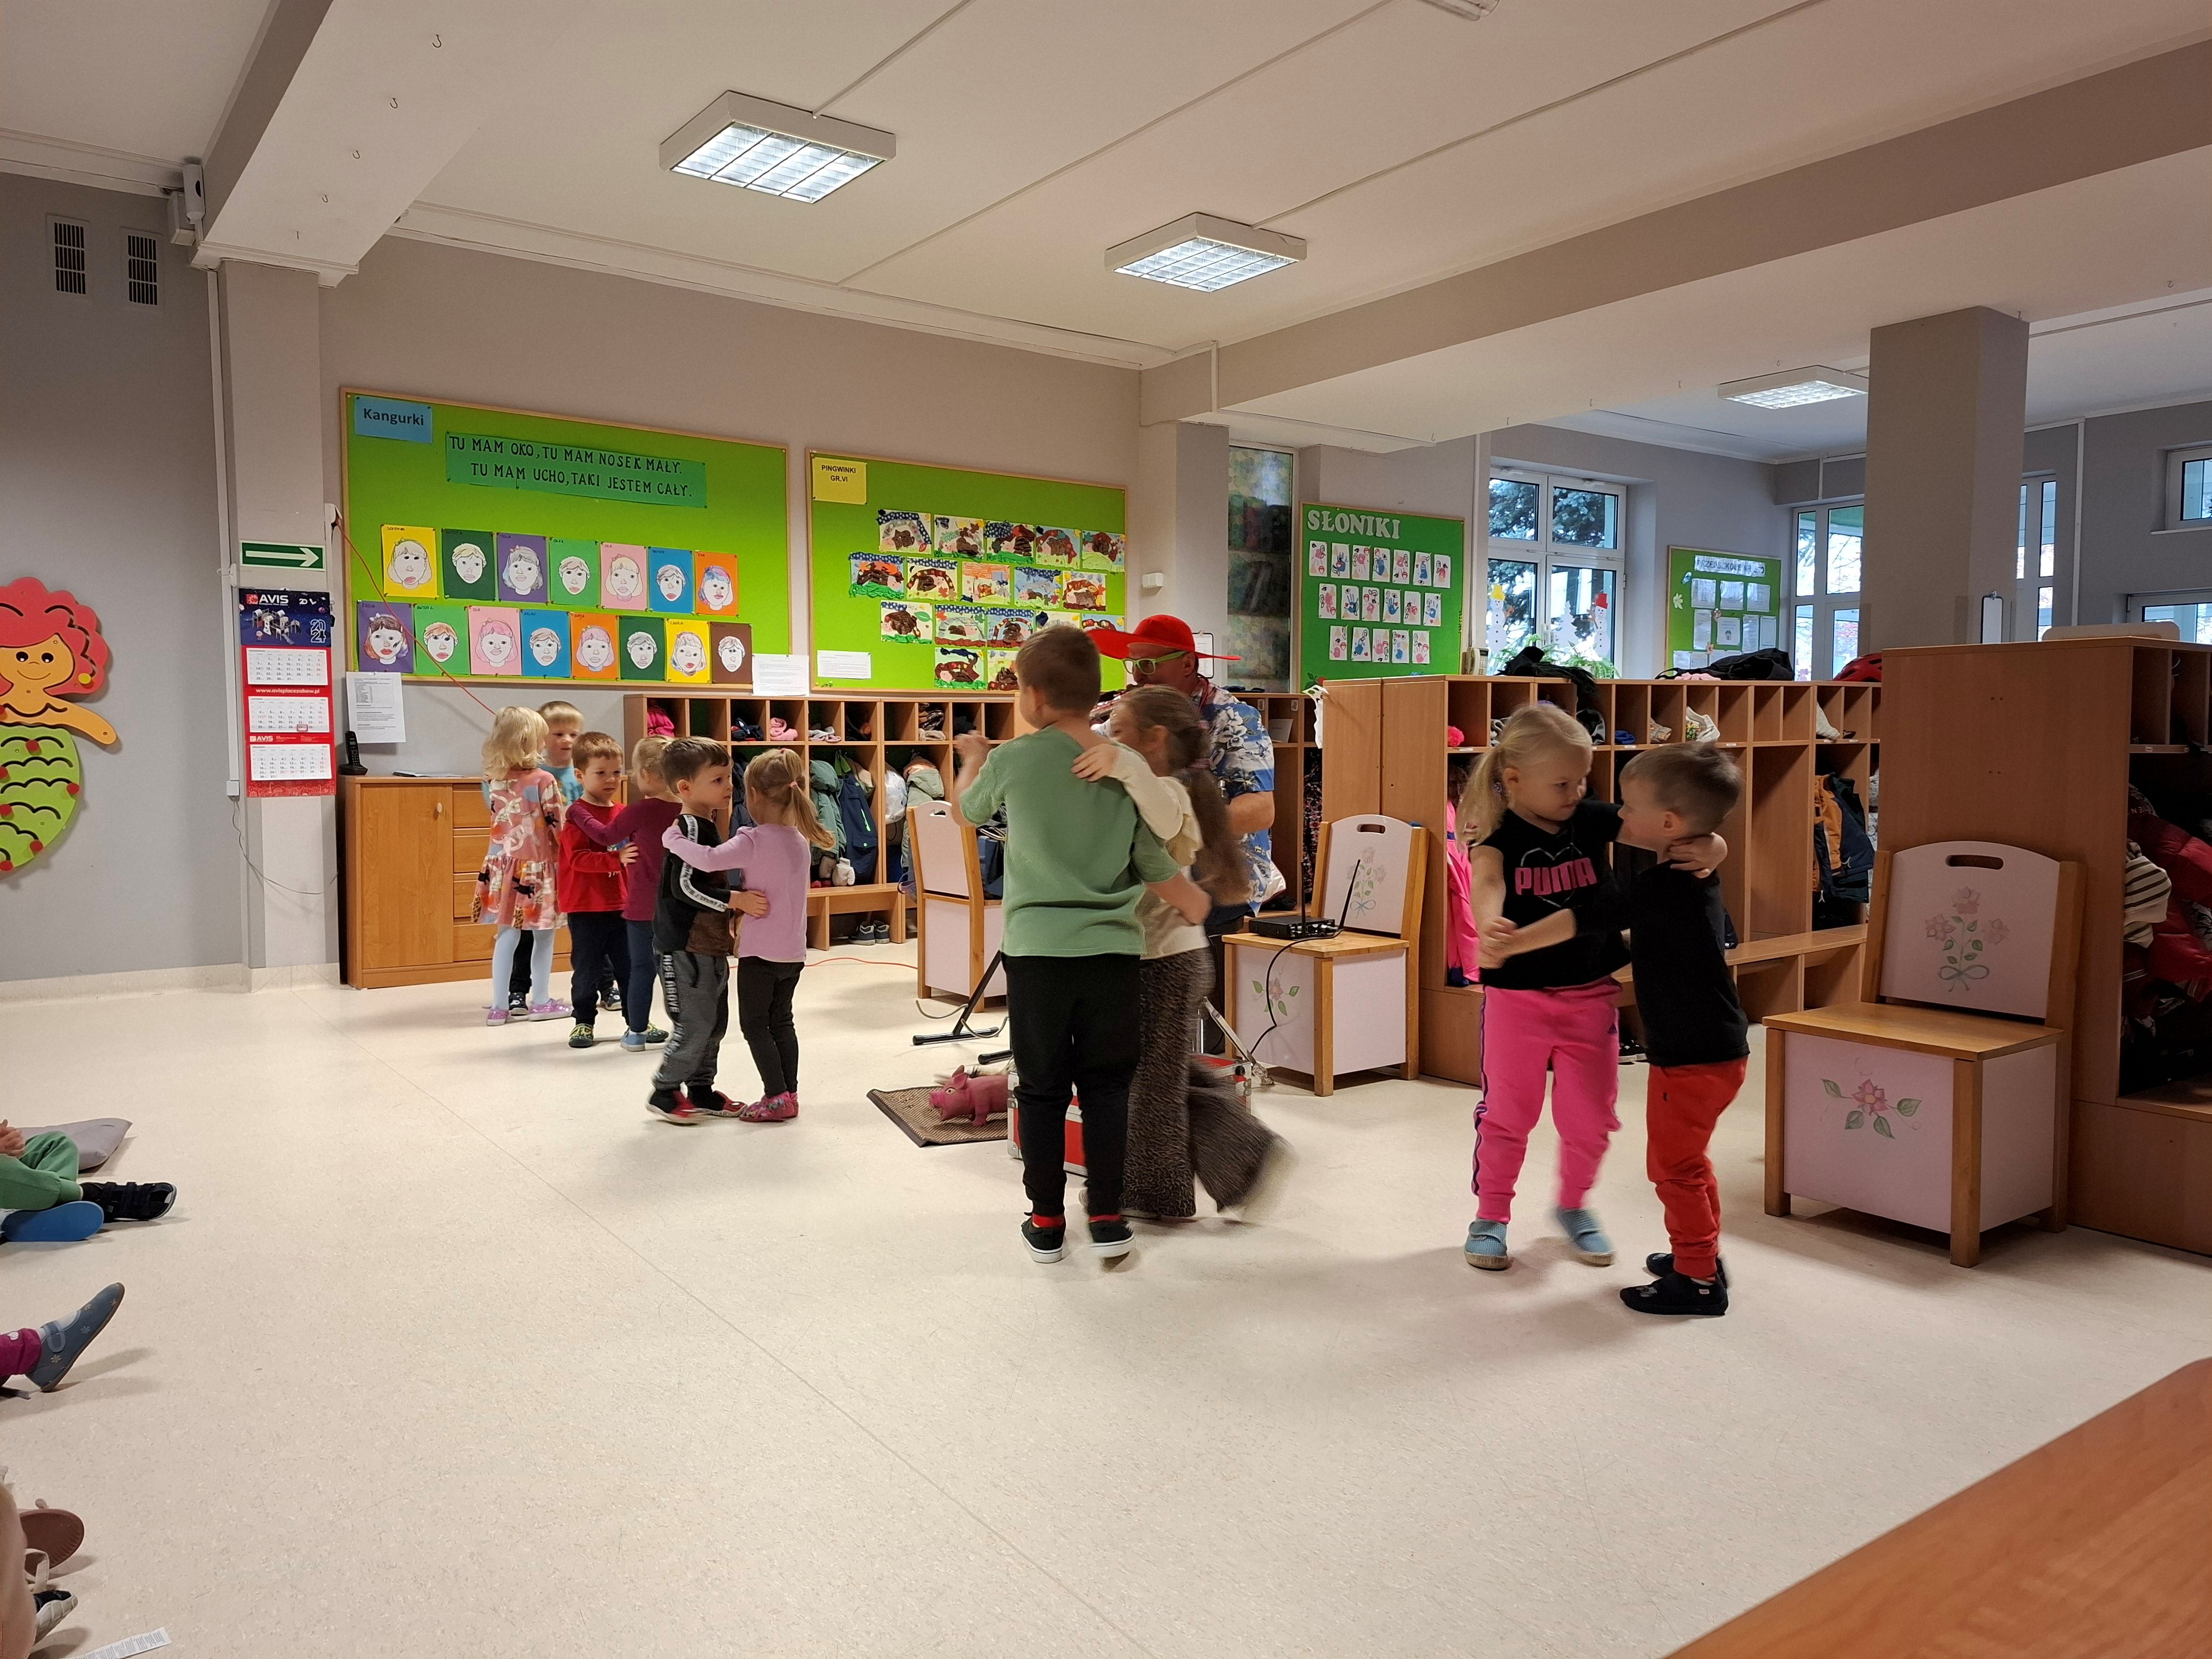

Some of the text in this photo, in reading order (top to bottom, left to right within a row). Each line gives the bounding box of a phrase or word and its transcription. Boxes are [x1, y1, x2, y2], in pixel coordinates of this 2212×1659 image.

[363, 408, 424, 426] Kangurki
[449, 435, 465, 451] TU
[472, 438, 504, 454] MAM
[542, 446, 558, 460] TU
[564, 448, 594, 464] MAM
[599, 452, 641, 470] NOSEK
[646, 458, 683, 474] MAŁY.
[821, 465, 856, 473] PINGWINKI
[471, 462, 488, 477] TU
[494, 464, 526, 480] MAM
[570, 472, 600, 487] TAKI
[607, 477, 652, 493] JESTEM
[657, 482, 692, 497] CAŁY.
[1307, 509, 1401, 539] SŁONIKI
[259, 594, 289, 604] AVIS
[1515, 857, 1598, 896] PUMA
